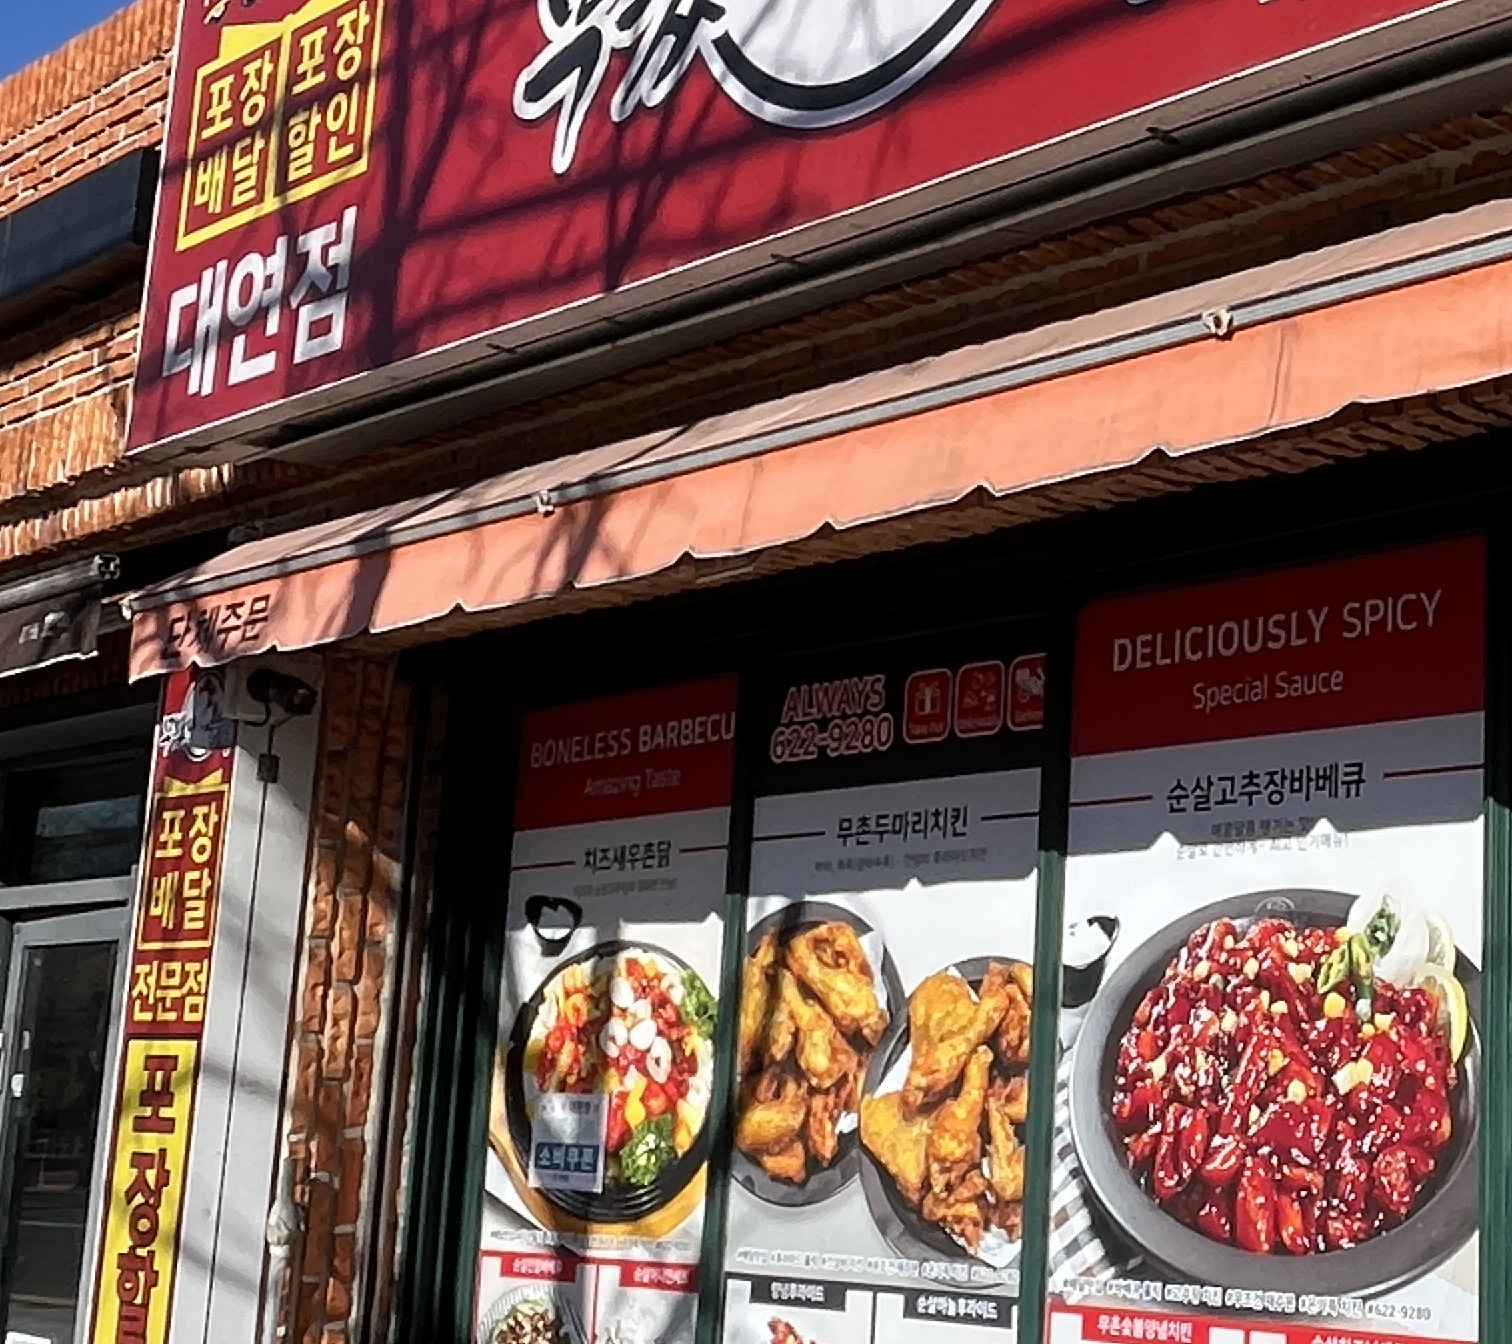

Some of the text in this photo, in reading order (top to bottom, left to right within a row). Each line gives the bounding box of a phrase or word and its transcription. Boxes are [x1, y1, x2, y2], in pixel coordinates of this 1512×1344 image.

[292, 0, 370, 95] 포장
[201, 50, 273, 141] 포장
[286, 87, 357, 182] 할인
[194, 136, 265, 215] 배달
[162, 206, 358, 399] 대연점
[1112, 589, 1442, 673] DELICIOUSLY SPICY
[781, 673, 886, 724] ALWAYS
[1192, 669, 1344, 715] Special Sauce
[530, 711, 735, 768] BONELESS BARBECU
[769, 712, 894, 764] 622-9280
[585, 768, 682, 798] Amazing Taste
[1167, 762, 1366, 814] 순살고추장바베큐
[155, 804, 219, 864] 포장
[837, 805, 968, 846] 무촌두마리치킨
[149, 867, 212, 932] 배달
[132, 959, 209, 1022] 전문점
